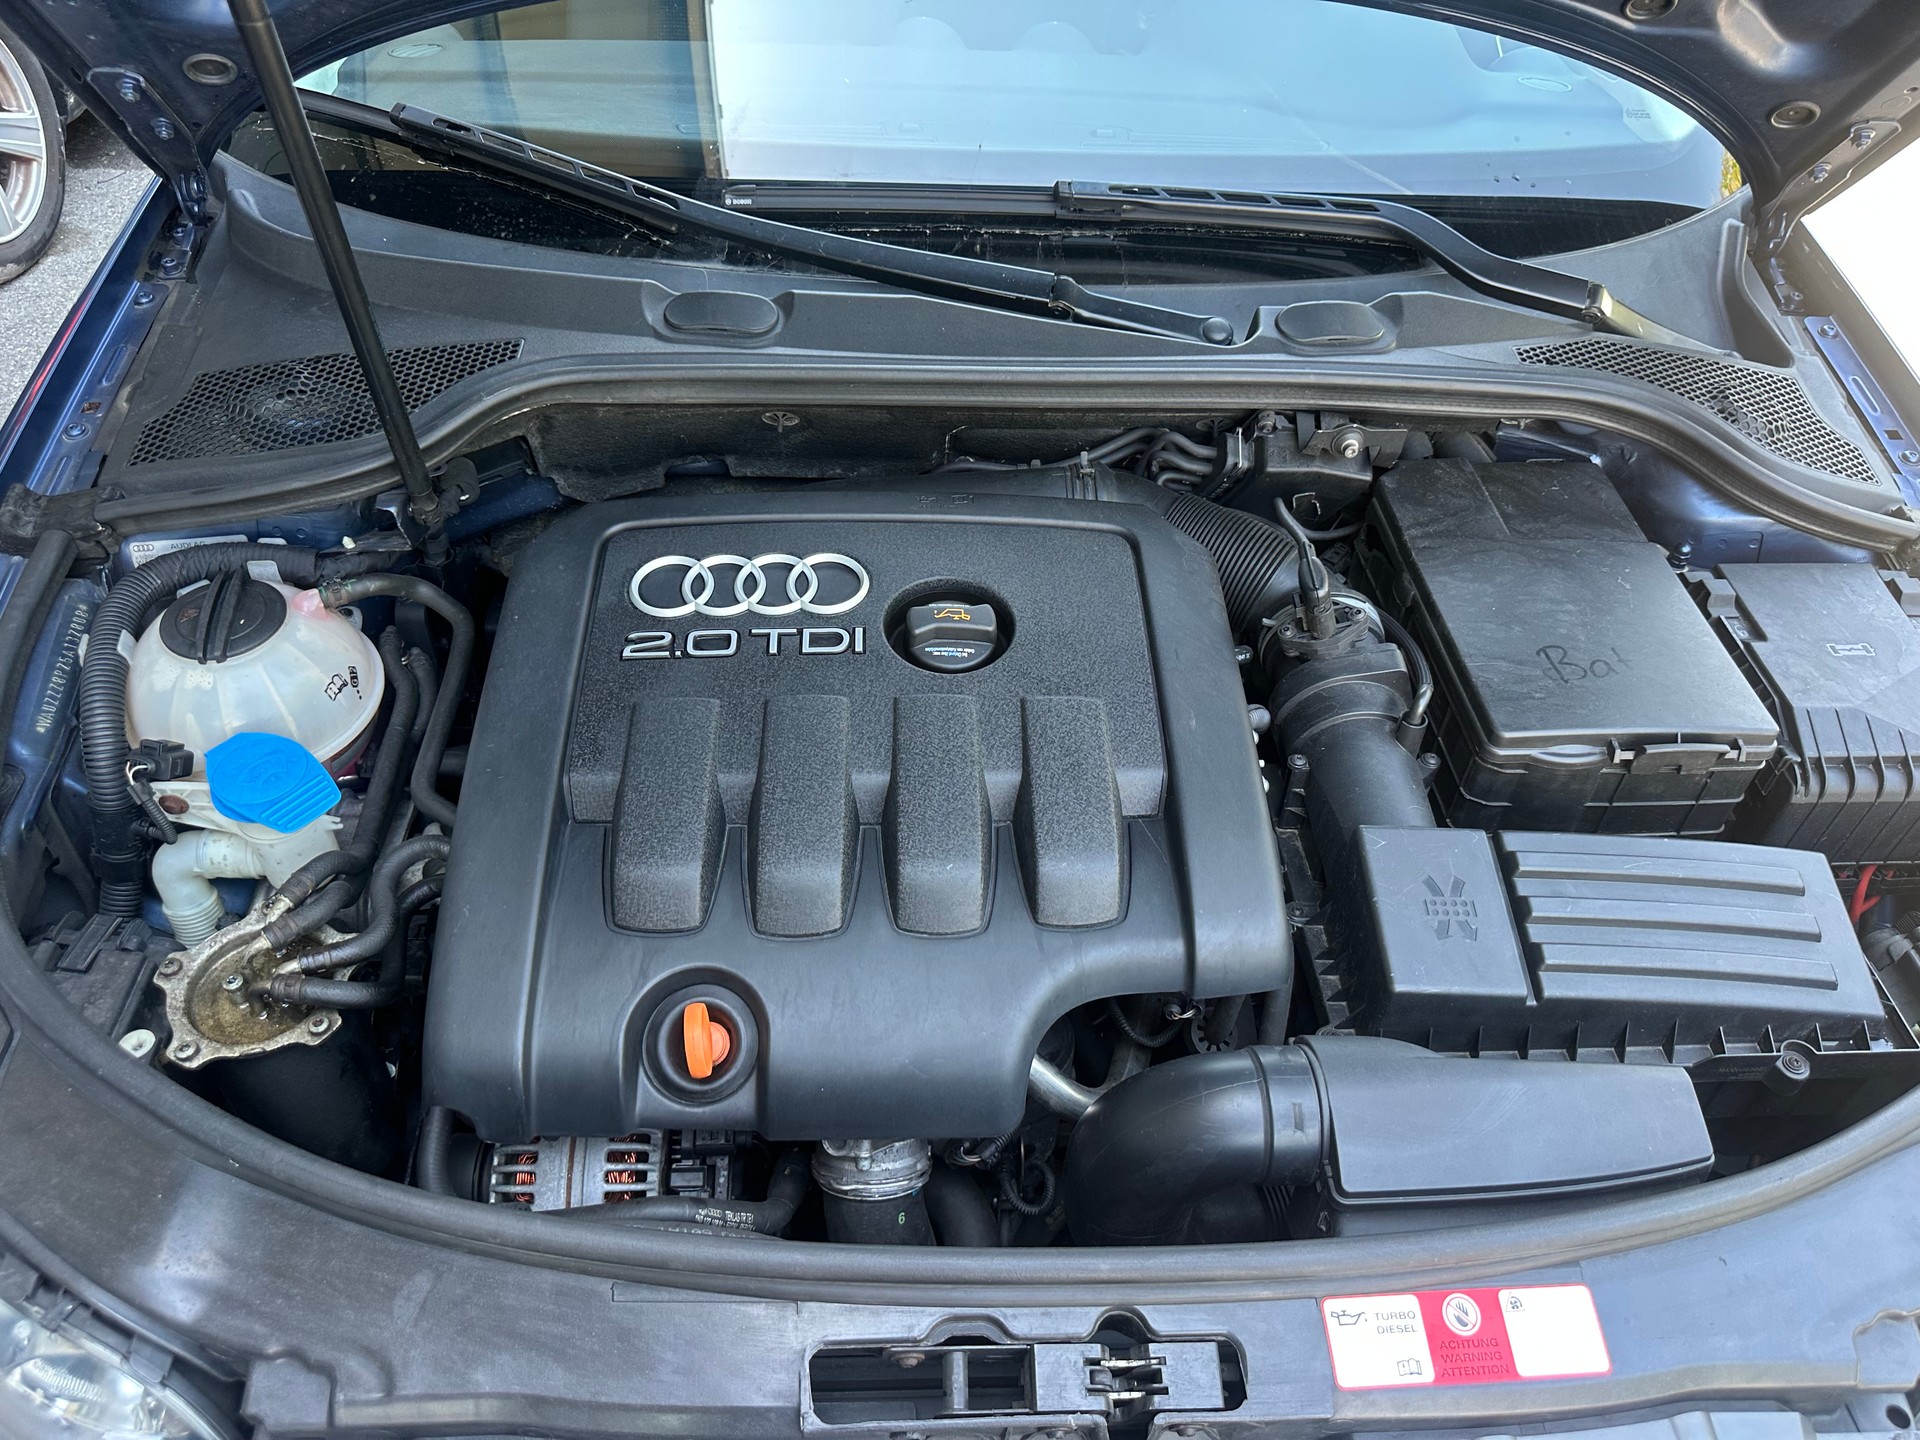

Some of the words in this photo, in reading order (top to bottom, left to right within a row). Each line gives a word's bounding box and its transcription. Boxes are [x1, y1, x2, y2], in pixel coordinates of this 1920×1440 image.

[621, 628, 739, 660] 2.0
[750, 626, 866, 656] TDI
[897, 1212, 906, 1225] 6
[1374, 1311, 1416, 1321] TURBO
[1376, 1324, 1418, 1334] DIESEL
[1440, 1338, 1499, 1350] ACHTUNG
[1440, 1351, 1503, 1363] WARNING
[1441, 1364, 1510, 1377] ATTENTION
